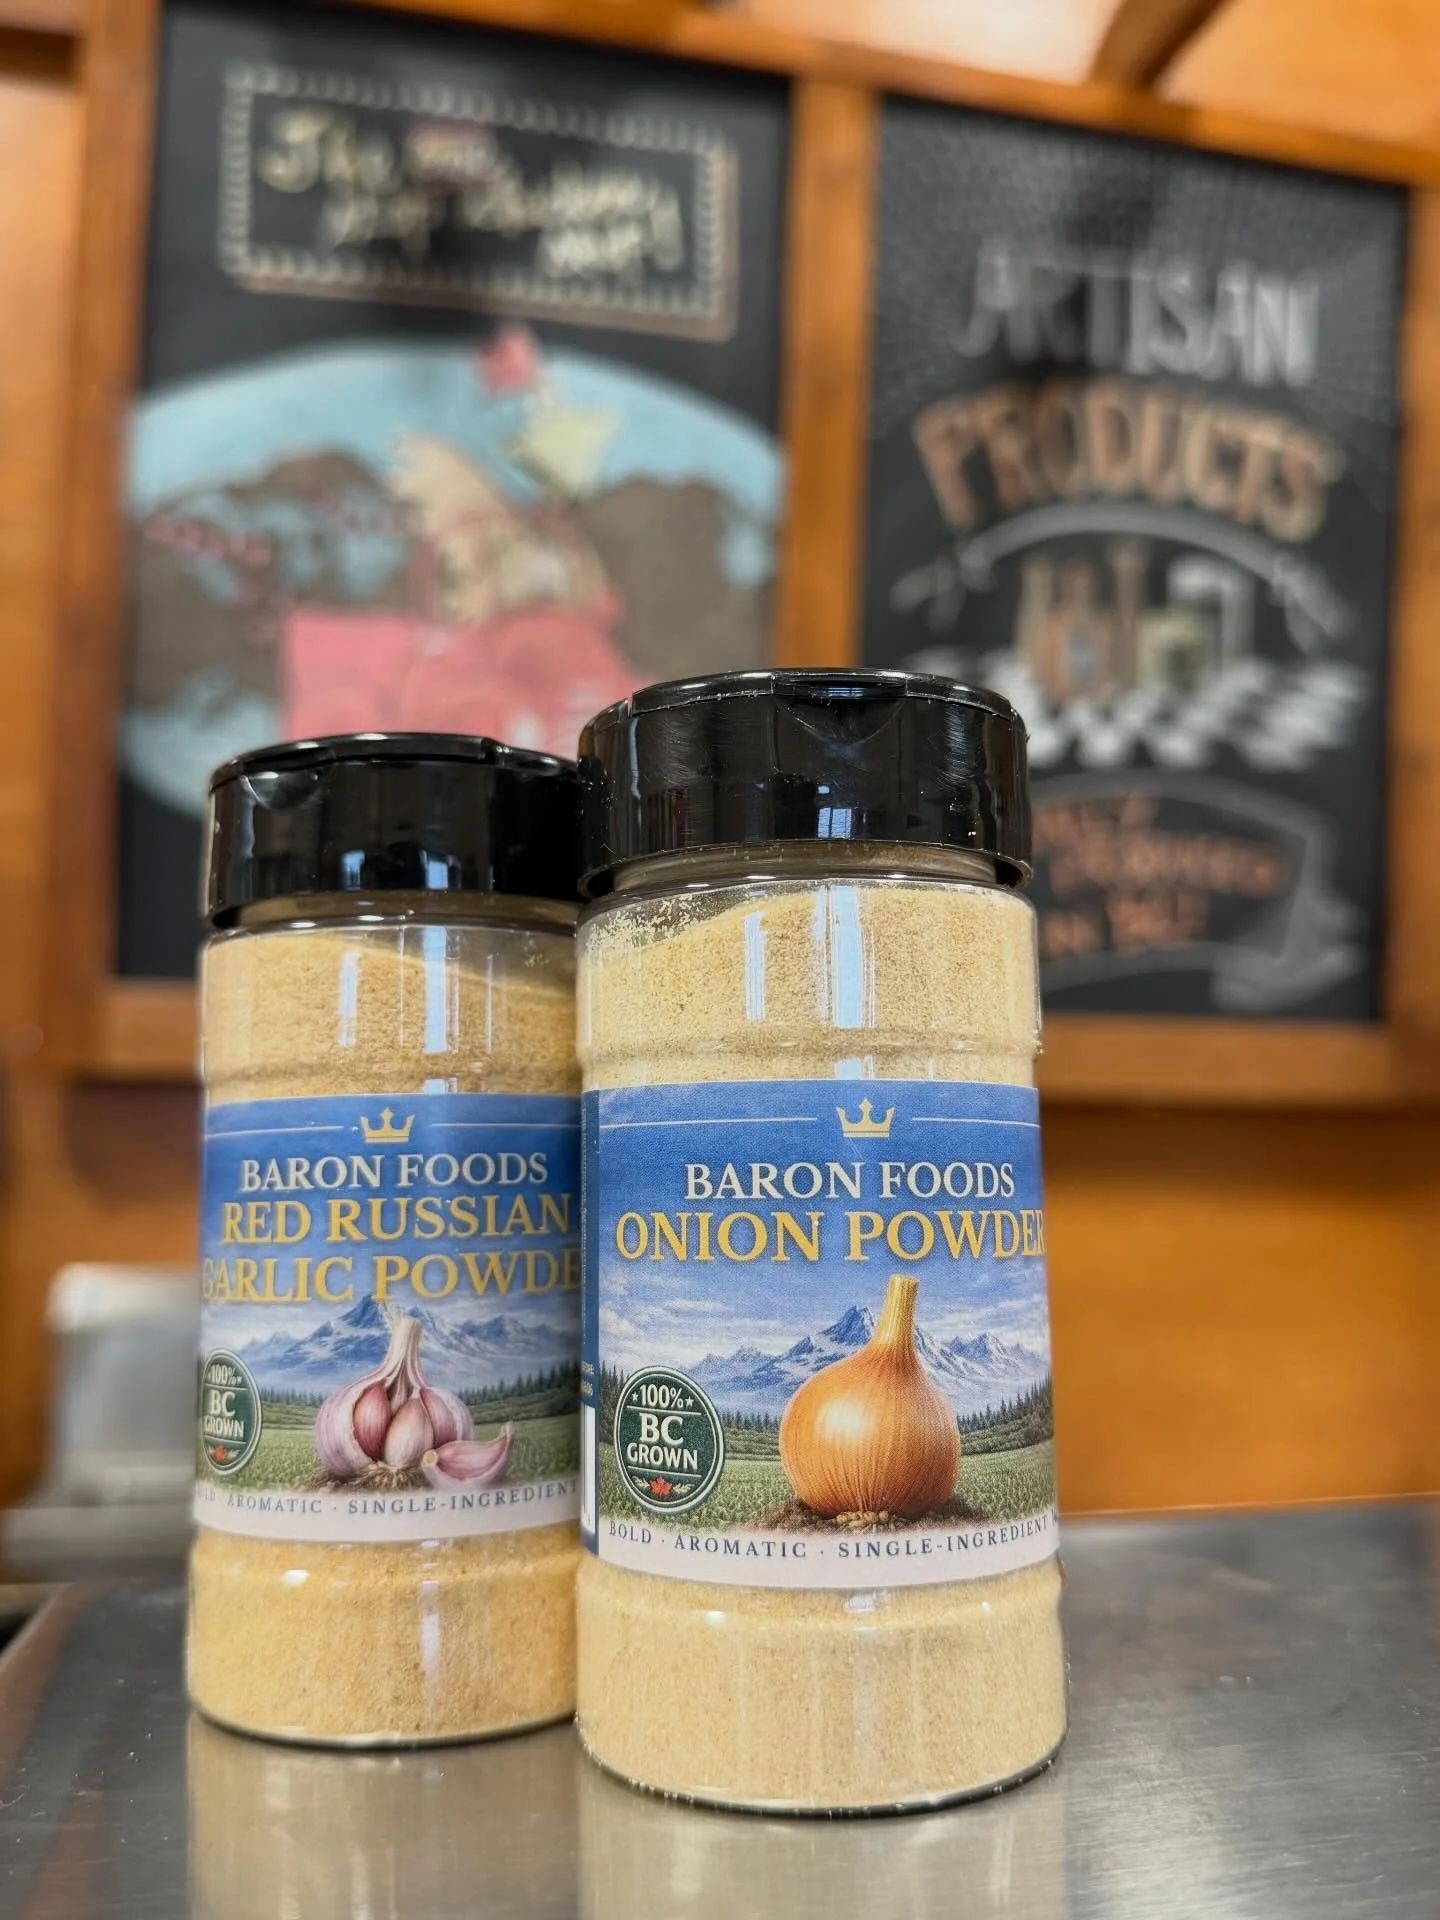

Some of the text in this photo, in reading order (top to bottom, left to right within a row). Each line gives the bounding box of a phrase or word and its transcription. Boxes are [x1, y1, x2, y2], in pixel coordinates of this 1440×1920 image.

[951, 237, 1319, 387] ARTISAN
[913, 376, 1346, 542] PRODUCTS
[240, 1152, 548, 1192] BARON FOODS
[684, 1160, 1016, 1200] BARON FOODS
[223, 1193, 573, 1244] RED RUSSIAN
[616, 1210, 826, 1262] ONION
[202, 1247, 581, 1303] GARLIC POWDE
[210, 1364, 237, 1386] 100%
[209, 1388, 236, 1417] BC
[638, 1383, 685, 1409] 100%
[203, 1414, 245, 1440] GROWN
[638, 1411, 685, 1446] BC
[626, 1442, 699, 1471] GROWN
[227, 1493, 323, 1514] AROMATIC
[347, 1479, 578, 1515] SINGLE-INGREDIENT
[609, 1520, 653, 1545] BOLD
[673, 1534, 807, 1559] AROMATIC
[837, 1515, 1048, 1559] SINGLE-INGREDIENT
